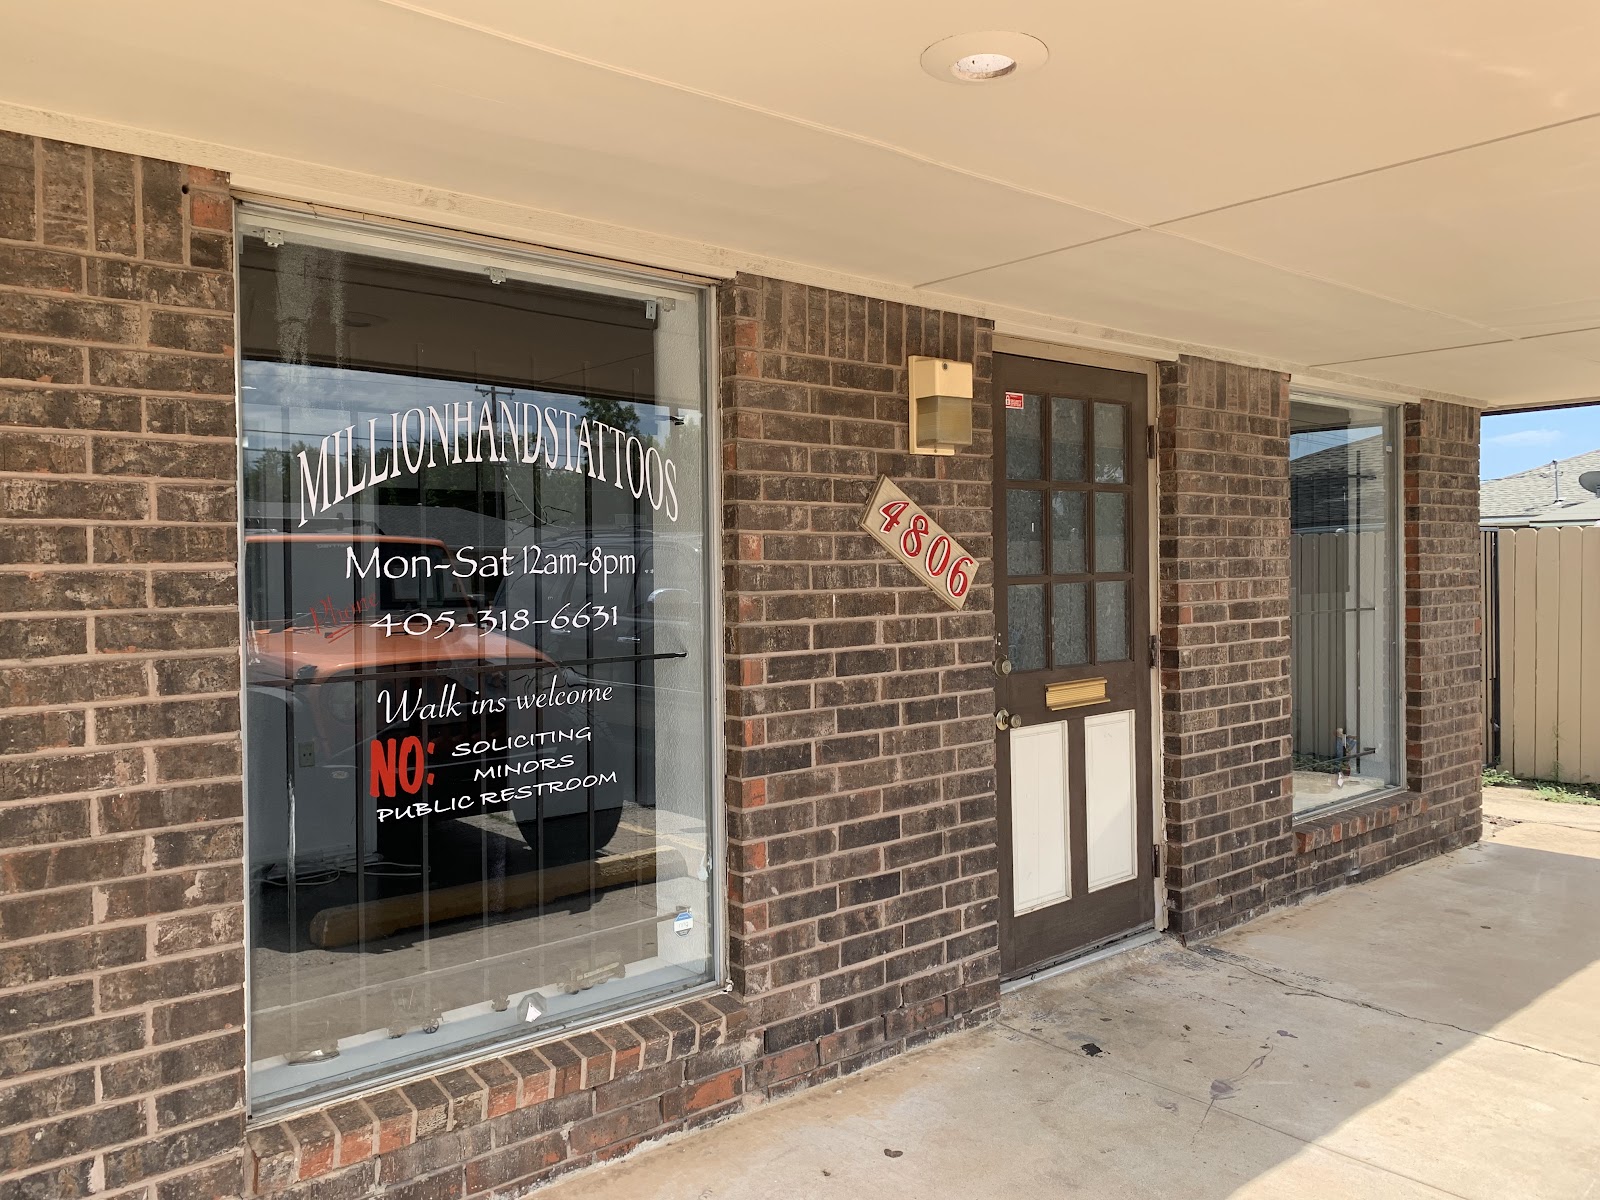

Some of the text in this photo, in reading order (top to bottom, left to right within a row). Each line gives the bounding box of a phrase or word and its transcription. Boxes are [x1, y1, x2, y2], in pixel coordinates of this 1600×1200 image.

[345, 545, 636, 593] Mon-Sat 12am-8pm
[879, 500, 974, 598] 4806
[369, 602, 618, 639] 405-318-6631
[377, 674, 614, 724] Walk ins welcome
[370, 726, 592, 798] NO: SOLICITING
[474, 755, 575, 781] MINORS
[377, 771, 617, 823] PUBLIC RESTROOM
